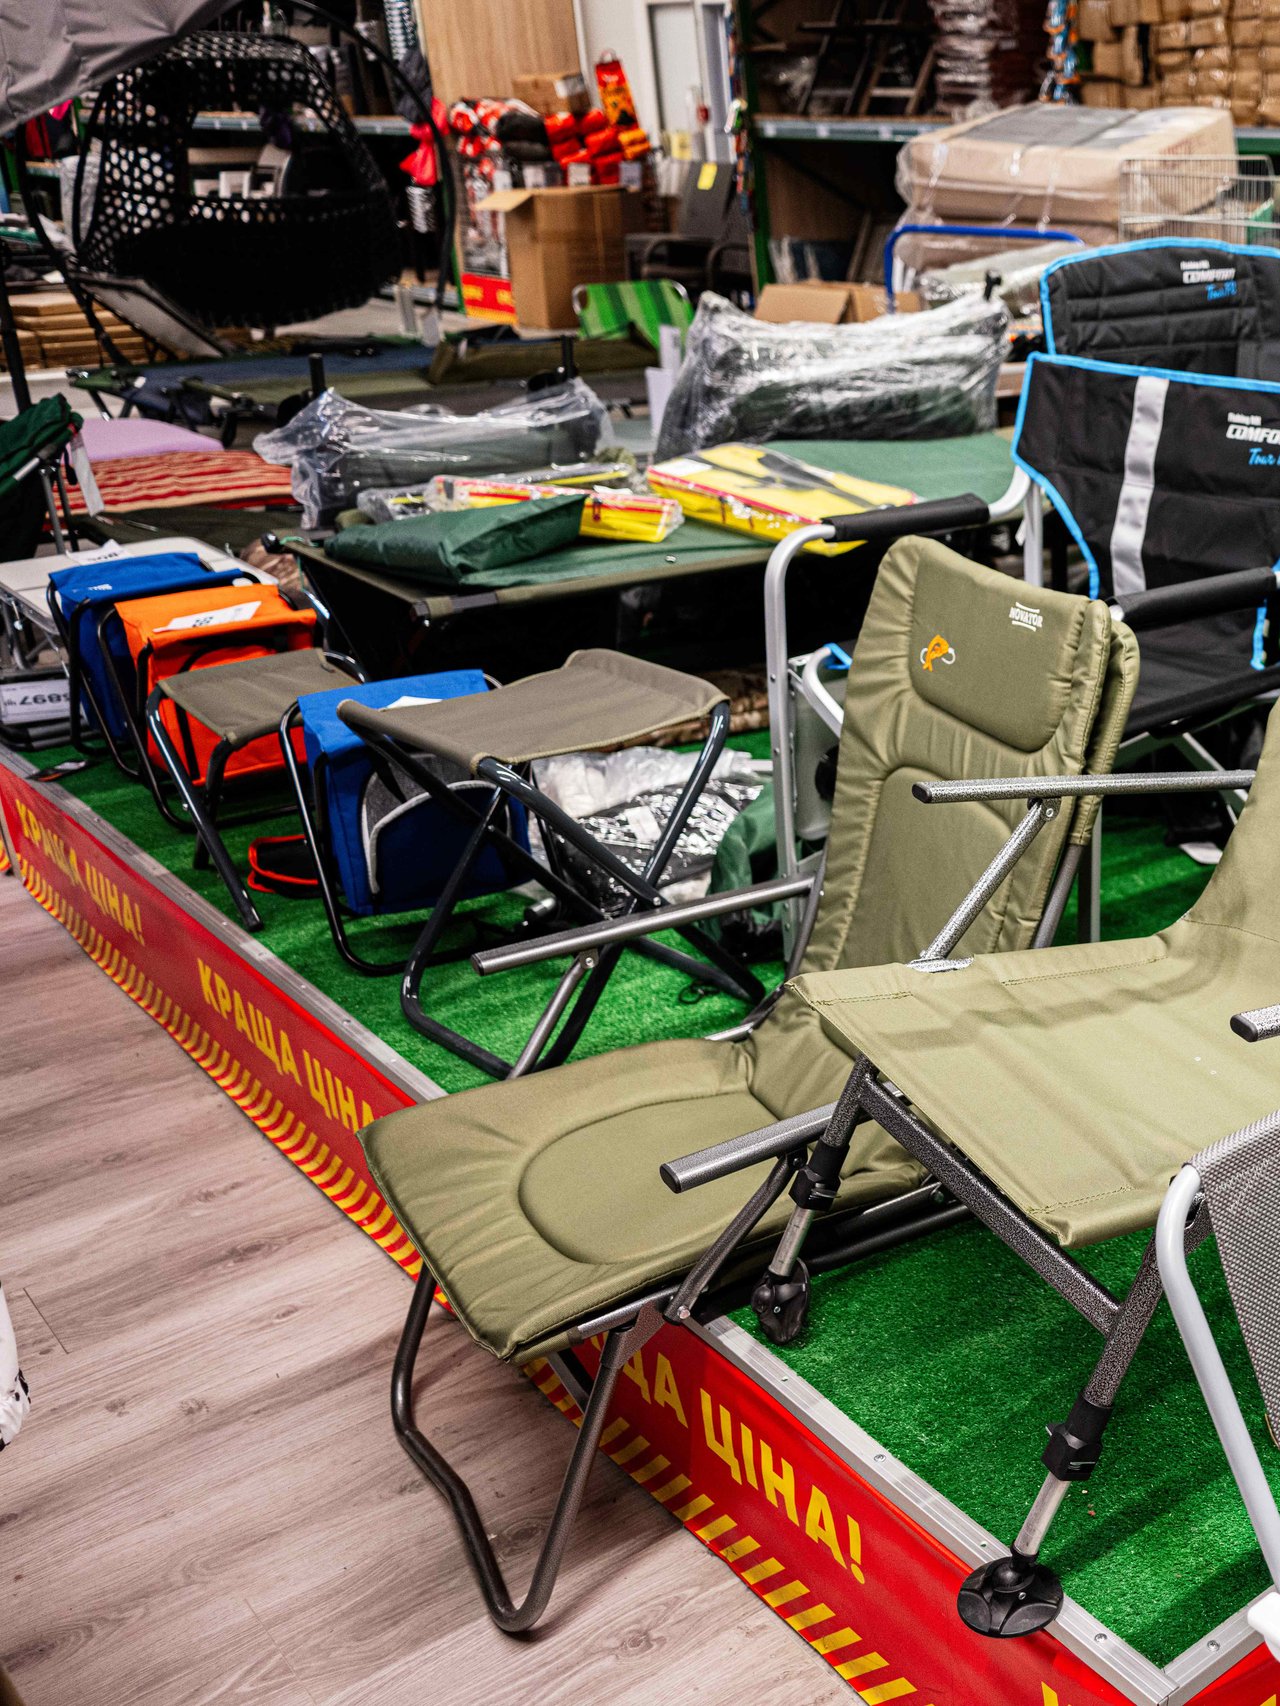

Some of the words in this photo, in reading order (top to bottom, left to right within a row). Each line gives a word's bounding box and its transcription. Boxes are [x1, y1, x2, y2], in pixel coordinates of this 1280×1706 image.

[1248, 447, 1276, 466] Tour
[1009, 606, 1043, 628] NOVATOR
[85, 860, 145, 946] ЦІНА!
[198, 957, 303, 1087] КРАЩА
[700, 1387, 865, 1584] ЦІНА!
